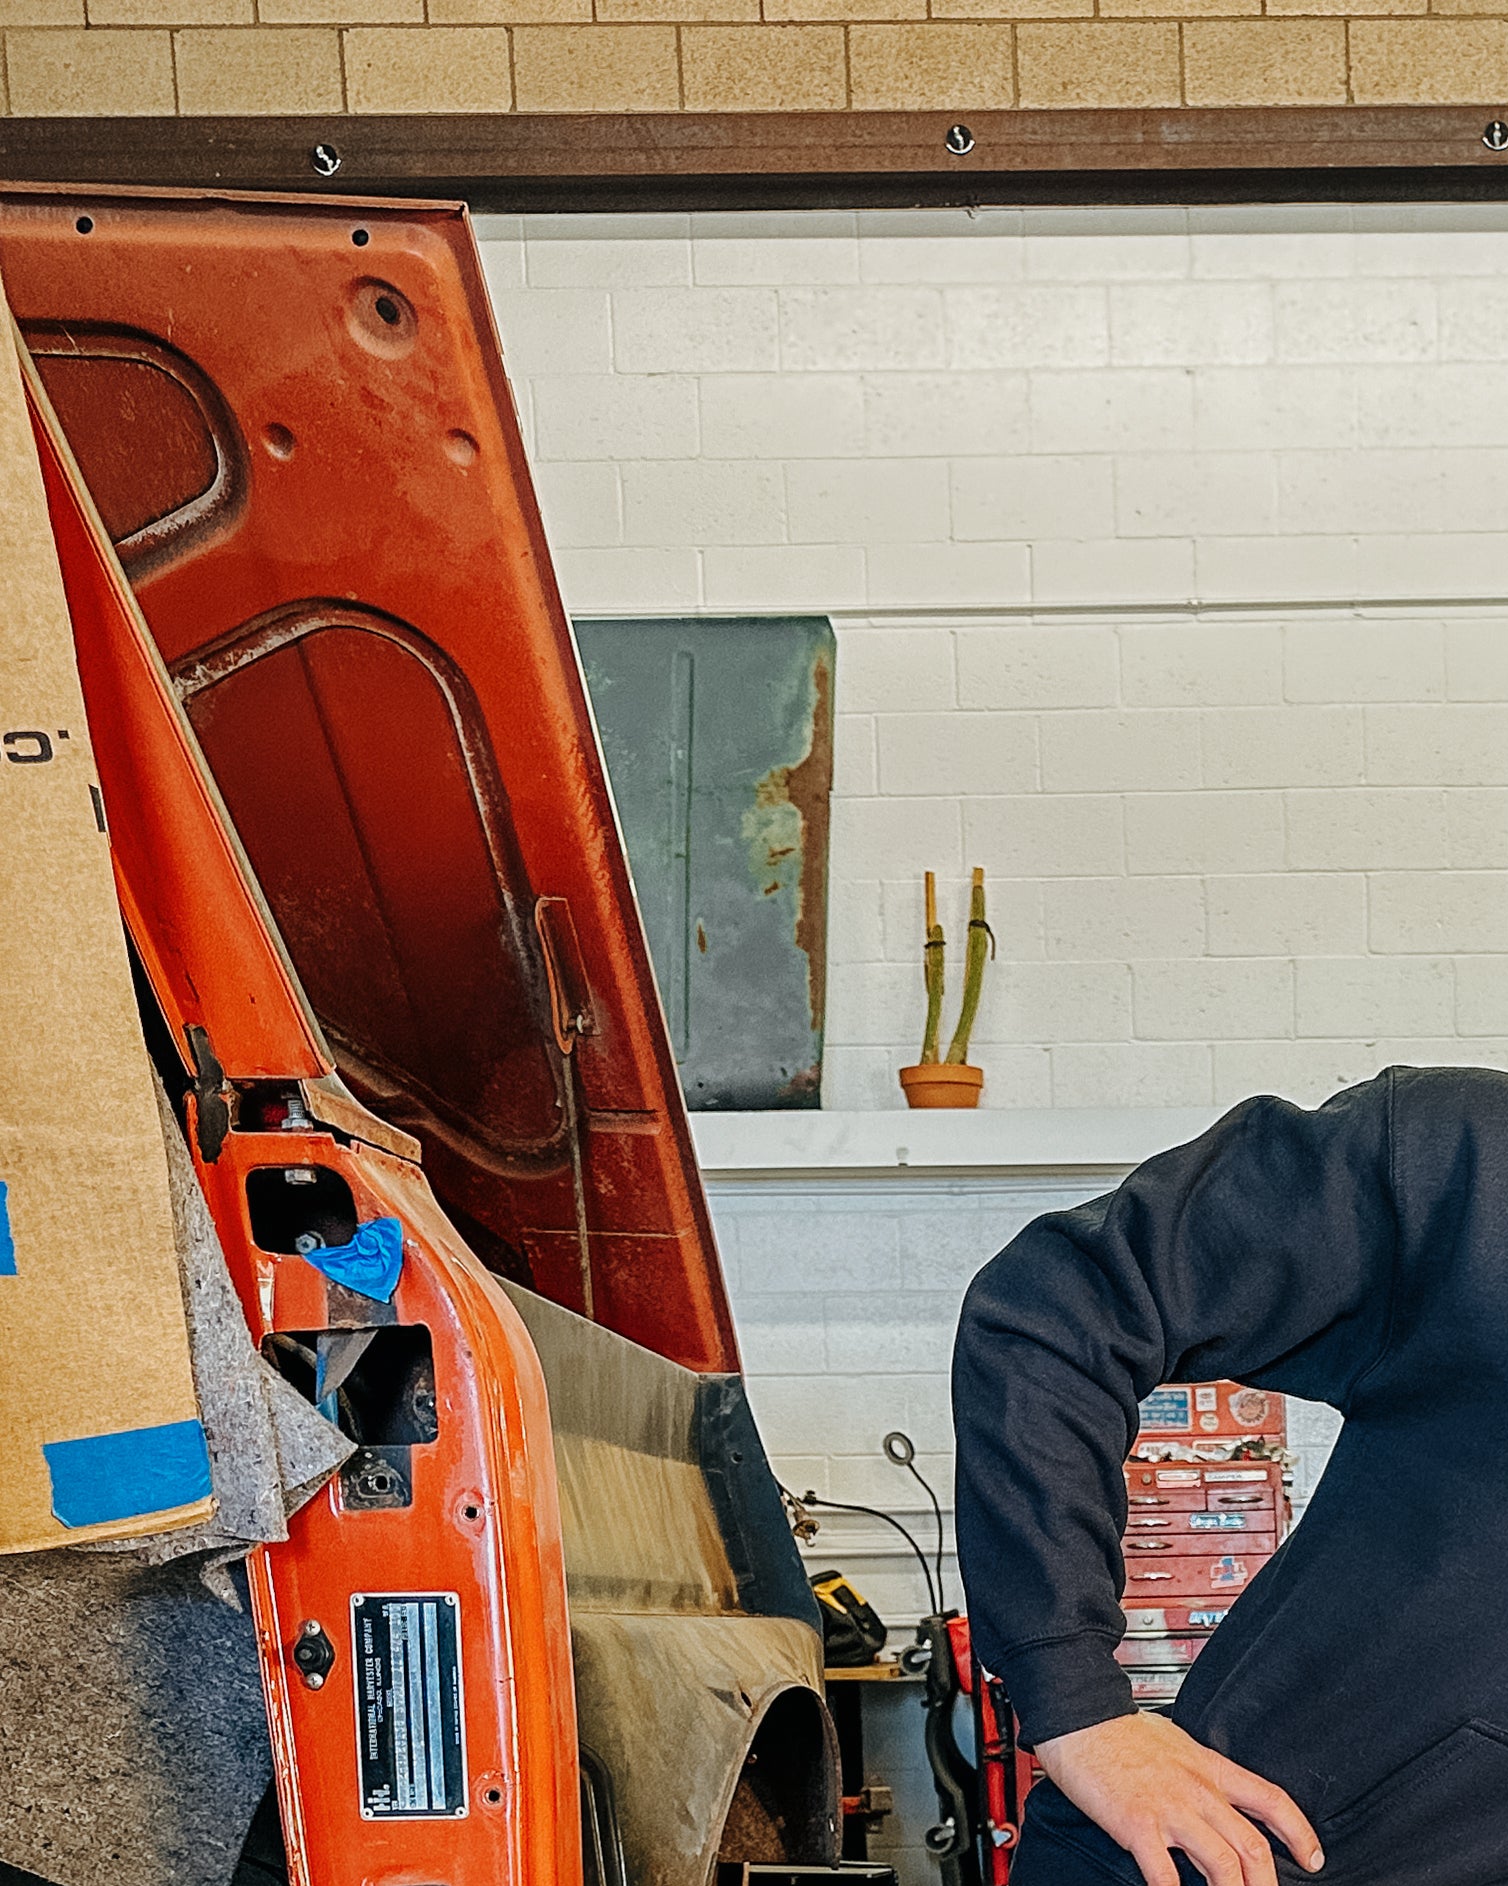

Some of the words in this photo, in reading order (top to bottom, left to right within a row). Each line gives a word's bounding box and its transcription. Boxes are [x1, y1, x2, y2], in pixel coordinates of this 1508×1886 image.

[362, 1617, 374, 1655] COMPANY
[364, 1657, 376, 1700] HARVESTER
[367, 1703, 379, 1761] INTERNATIONAL
